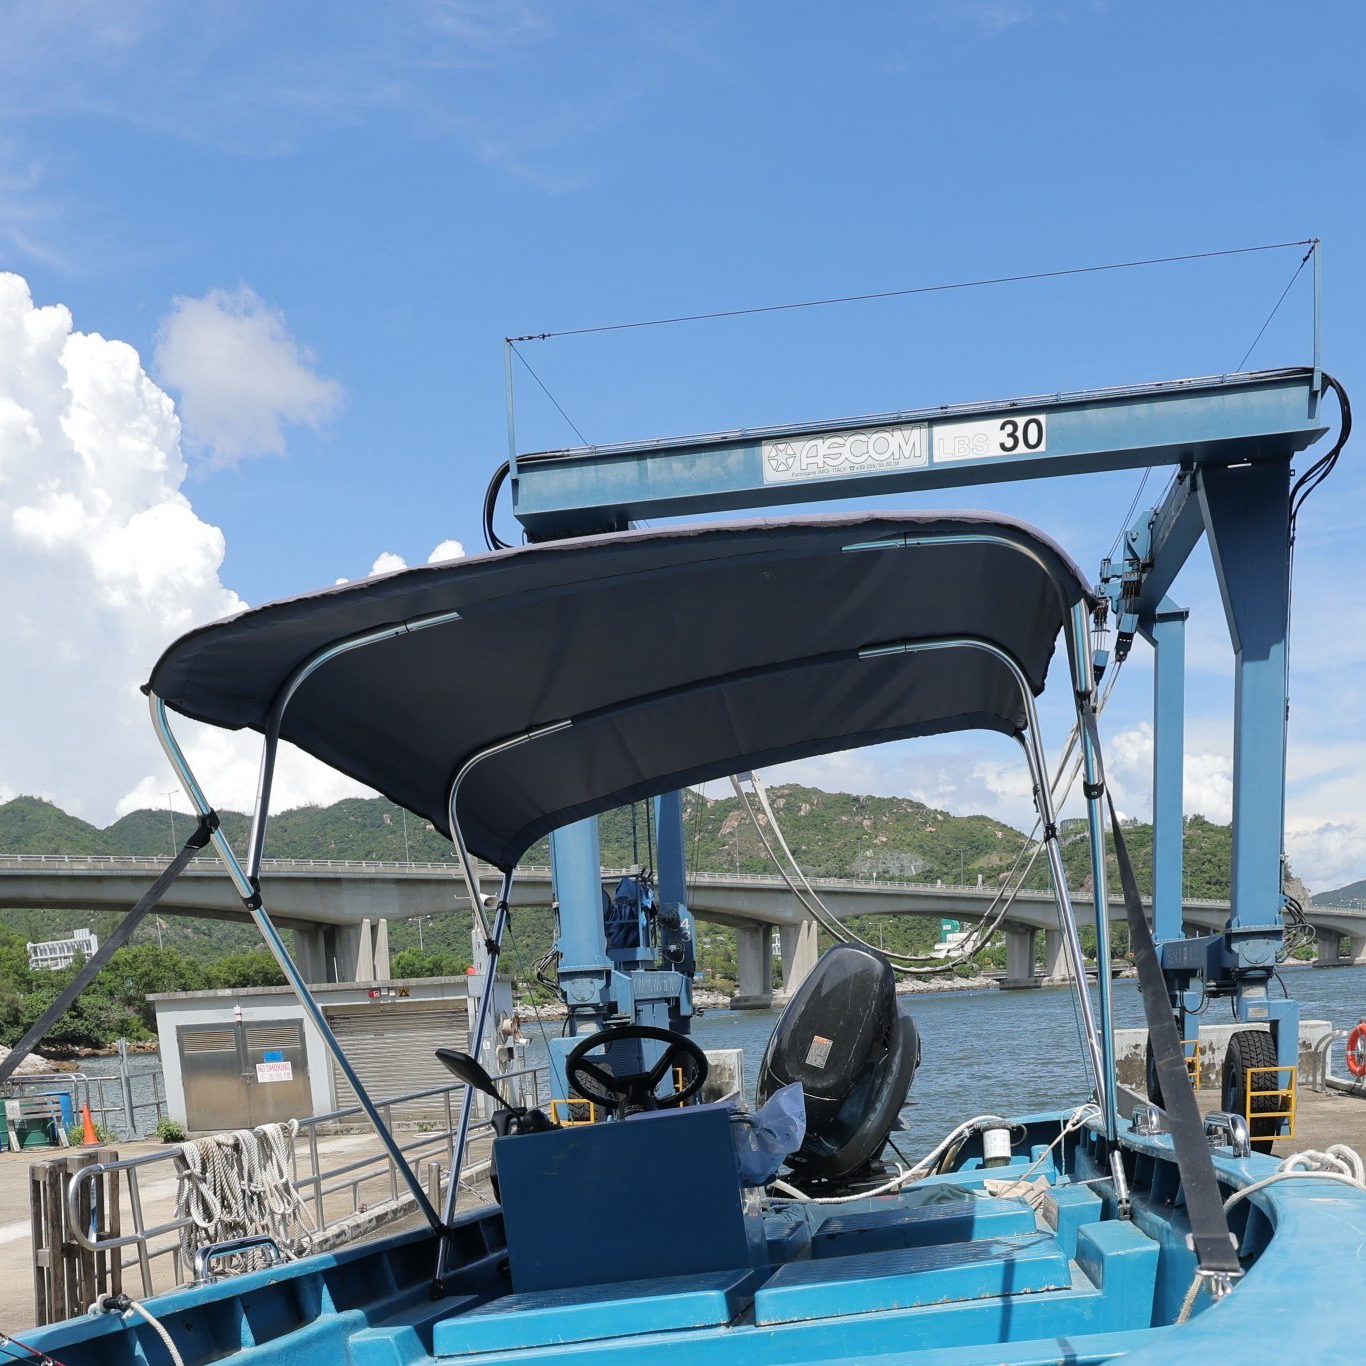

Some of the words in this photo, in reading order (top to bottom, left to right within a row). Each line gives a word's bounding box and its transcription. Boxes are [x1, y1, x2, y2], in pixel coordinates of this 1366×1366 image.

[799, 426, 922, 470] ASCOM
[938, 432, 989, 458] LBS
[998, 417, 1044, 452] 30
[266, 1063, 291, 1072] SMOKING
